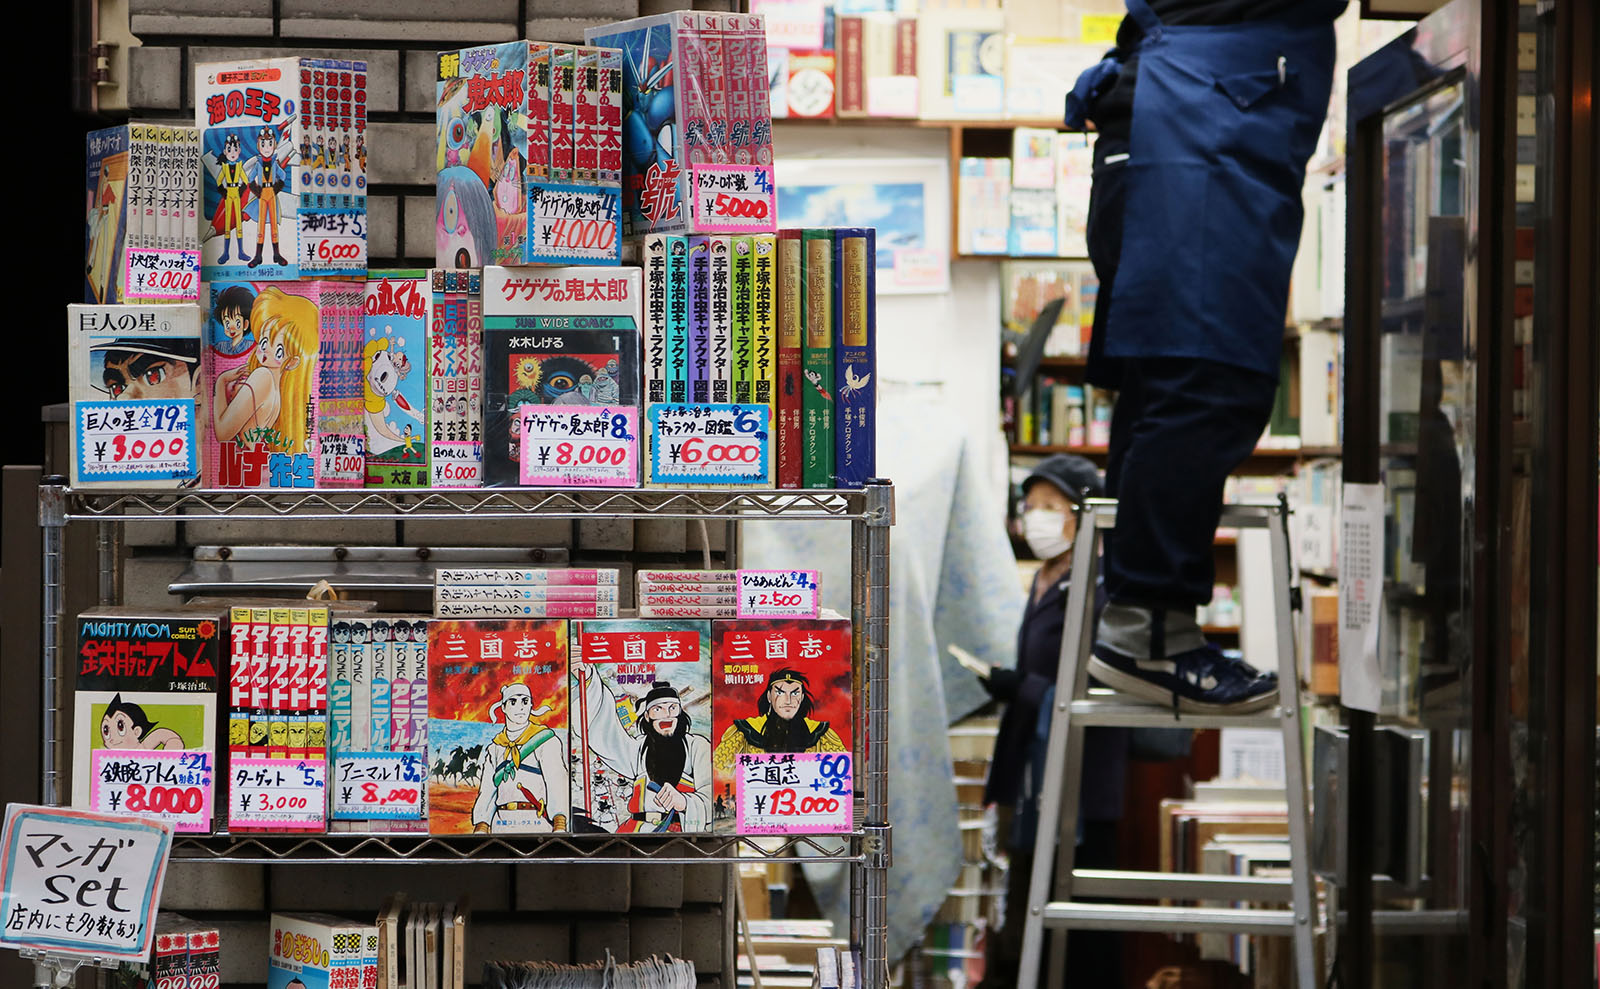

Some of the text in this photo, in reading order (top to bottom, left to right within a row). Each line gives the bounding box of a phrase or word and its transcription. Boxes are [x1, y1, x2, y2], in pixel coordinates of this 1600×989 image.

[683, 16, 694, 28] St
[705, 16, 717, 29] St
[728, 17, 740, 29] St
[749, 17, 760, 29] St
[440, 53, 459, 79] 新
[462, 49, 499, 73] ゲゲゲの
[206, 88, 281, 126] 海の王子
[301, 70, 312, 131] 海の王子
[314, 70, 325, 132] 海の王子
[326, 72, 339, 133] 海の王子
[340, 72, 352, 133] 海の王子
[354, 74, 367, 134] 海の王子
[463, 69, 524, 114] 鬼太郎
[129, 142, 143, 207] 快傑ハリマオ
[144, 143, 156, 216] 快傑ハリマオ 2
[158, 145, 171, 217] 快傑ハリマオ 3
[171, 146, 183, 209] 快傑ハリマオ
[185, 146, 198, 209] 快傑ハリマオ
[301, 213, 348, 235] 海の王子
[129, 253, 185, 271] 快傑ハリマオ
[501, 278, 629, 302] ゲゲゲの鬼太郎
[80, 313, 156, 332] 巨人の星
[432, 303, 445, 377] 日の丸くん
[445, 304, 457, 378] 日の丸くん
[456, 302, 468, 376] 日の丸くん
[469, 301, 480, 374] 日の丸くん
[515, 317, 615, 329] SUN WIDE COMICS
[649, 256, 664, 403] 手塚治虫キャラクター図鑑
[671, 256, 686, 403] 手塚治虫キャラクター図鑑
[693, 256, 708, 403] 手塚治虫キャラクター図鑑
[713, 256, 728, 403] 手塚治虫キャラクター図鑑
[736, 257, 751, 403] 手塚治虫キャラクター図鑑
[756, 256, 771, 403] 手塚治虫キャラクター図鑑
[508, 336, 620, 350] 水木しげる 1
[87, 411, 143, 432] 巨人の星
[523, 414, 609, 438] ゲゲゲの鬼太郎
[657, 420, 735, 436] キャラクター図鑑
[95, 434, 184, 462] ¥3,000
[219, 440, 315, 488] ルナ先生
[433, 447, 468, 458] 日の丸くん
[538, 442, 627, 466] ¥8,000
[669, 437, 760, 468] ¥6,000
[742, 574, 794, 589] ひるあんどん
[81, 622, 170, 638] MIGHTY ATOM
[444, 638, 538, 660] 三国志
[729, 638, 823, 660] 三国志
[80, 640, 216, 677] 鉄腕アトム
[231, 624, 250, 707] ターゲット
[250, 625, 269, 707] ターゲット
[270, 626, 289, 708] ターゲット
[289, 626, 308, 708] ターゲット
[308, 626, 327, 708] ターゲット
[588, 639, 681, 661] 三国志
[332, 685, 351, 747] アニマル
[371, 684, 390, 746] アニマル
[391, 684, 411, 747] アニマル
[410, 684, 428, 747] アニマル
[100, 760, 178, 785] 鉄腕アトム
[236, 769, 285, 787] ターゲット
[746, 764, 800, 786] 三国志
[240, 793, 307, 812] ¥3,000
[25, 834, 135, 873] マンガ
[5, 903, 144, 942] 店内にも多数あり!
